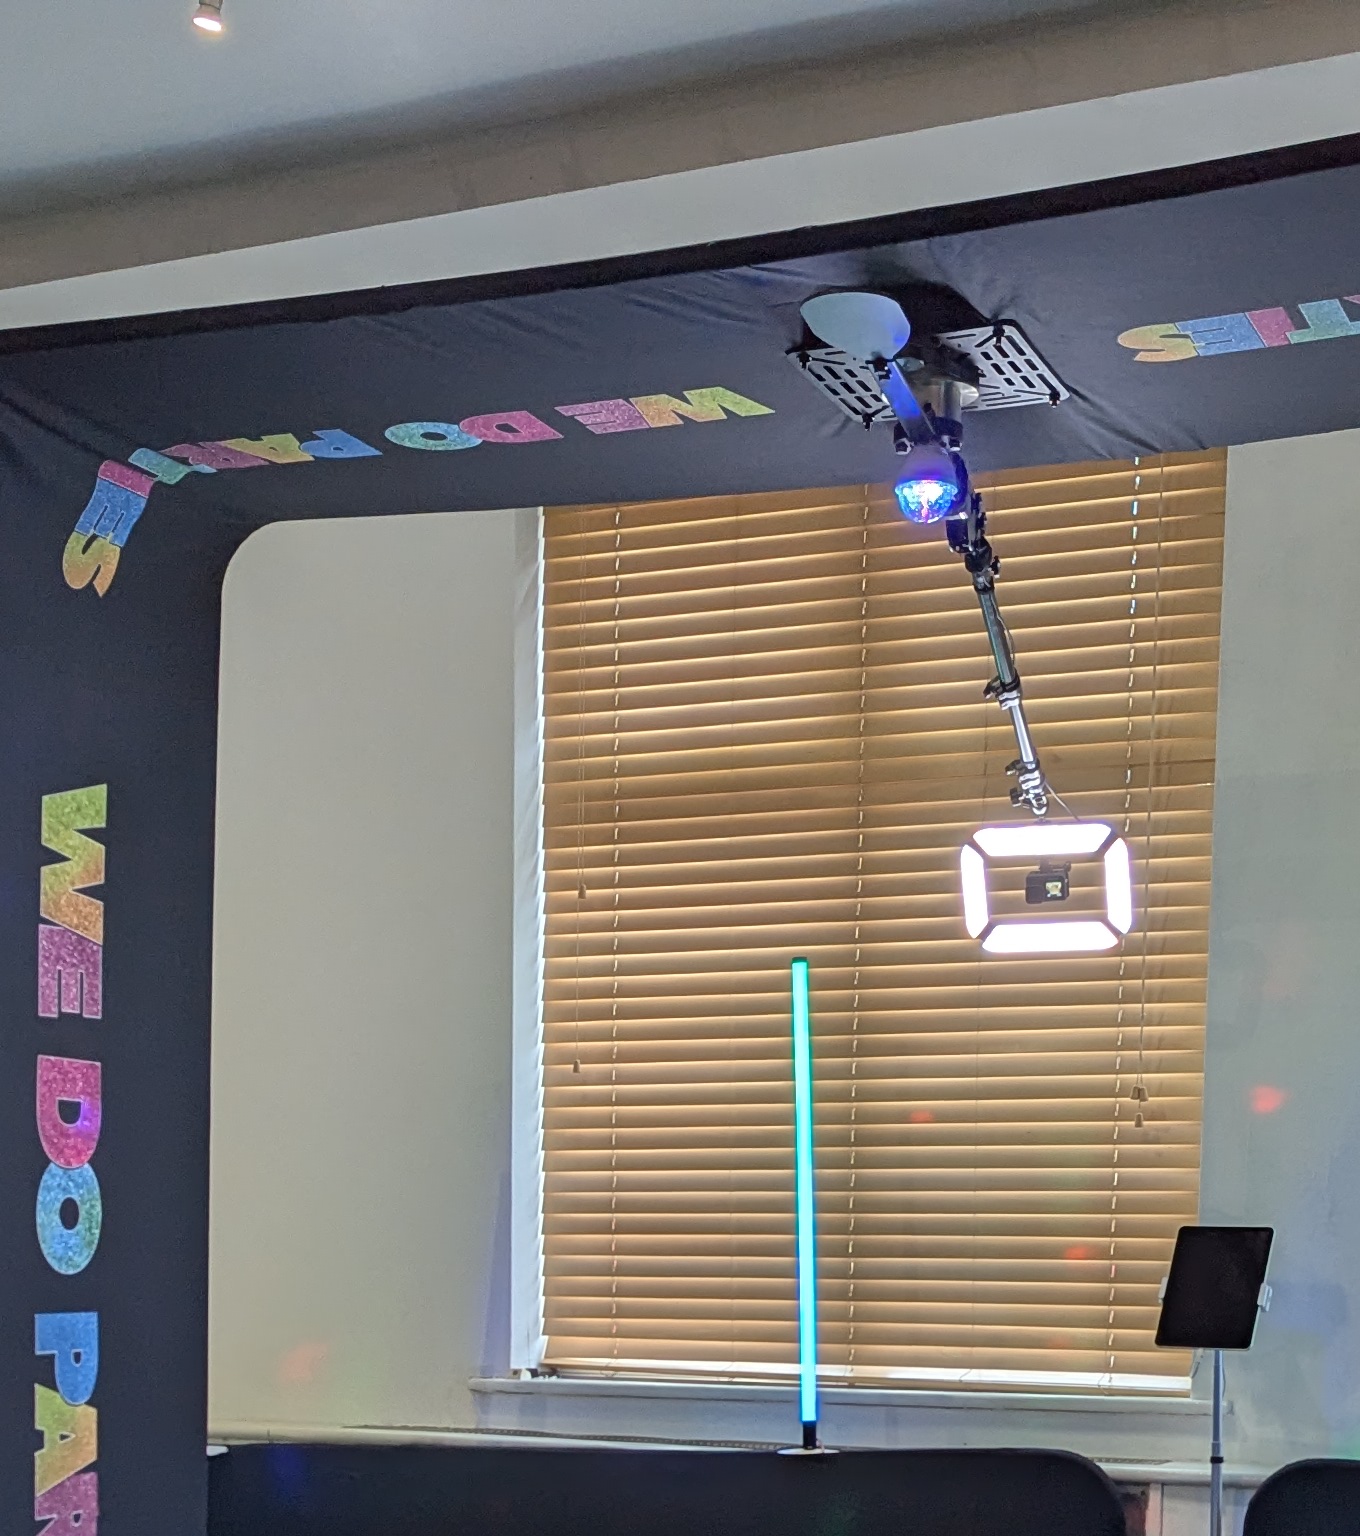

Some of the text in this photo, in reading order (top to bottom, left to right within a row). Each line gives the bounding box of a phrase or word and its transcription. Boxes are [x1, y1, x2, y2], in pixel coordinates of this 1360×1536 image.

[384, 410, 566, 452] DO
[554, 386, 776, 436] WE
[38, 783, 108, 1020] WE
[35, 1054, 103, 1275] DO
